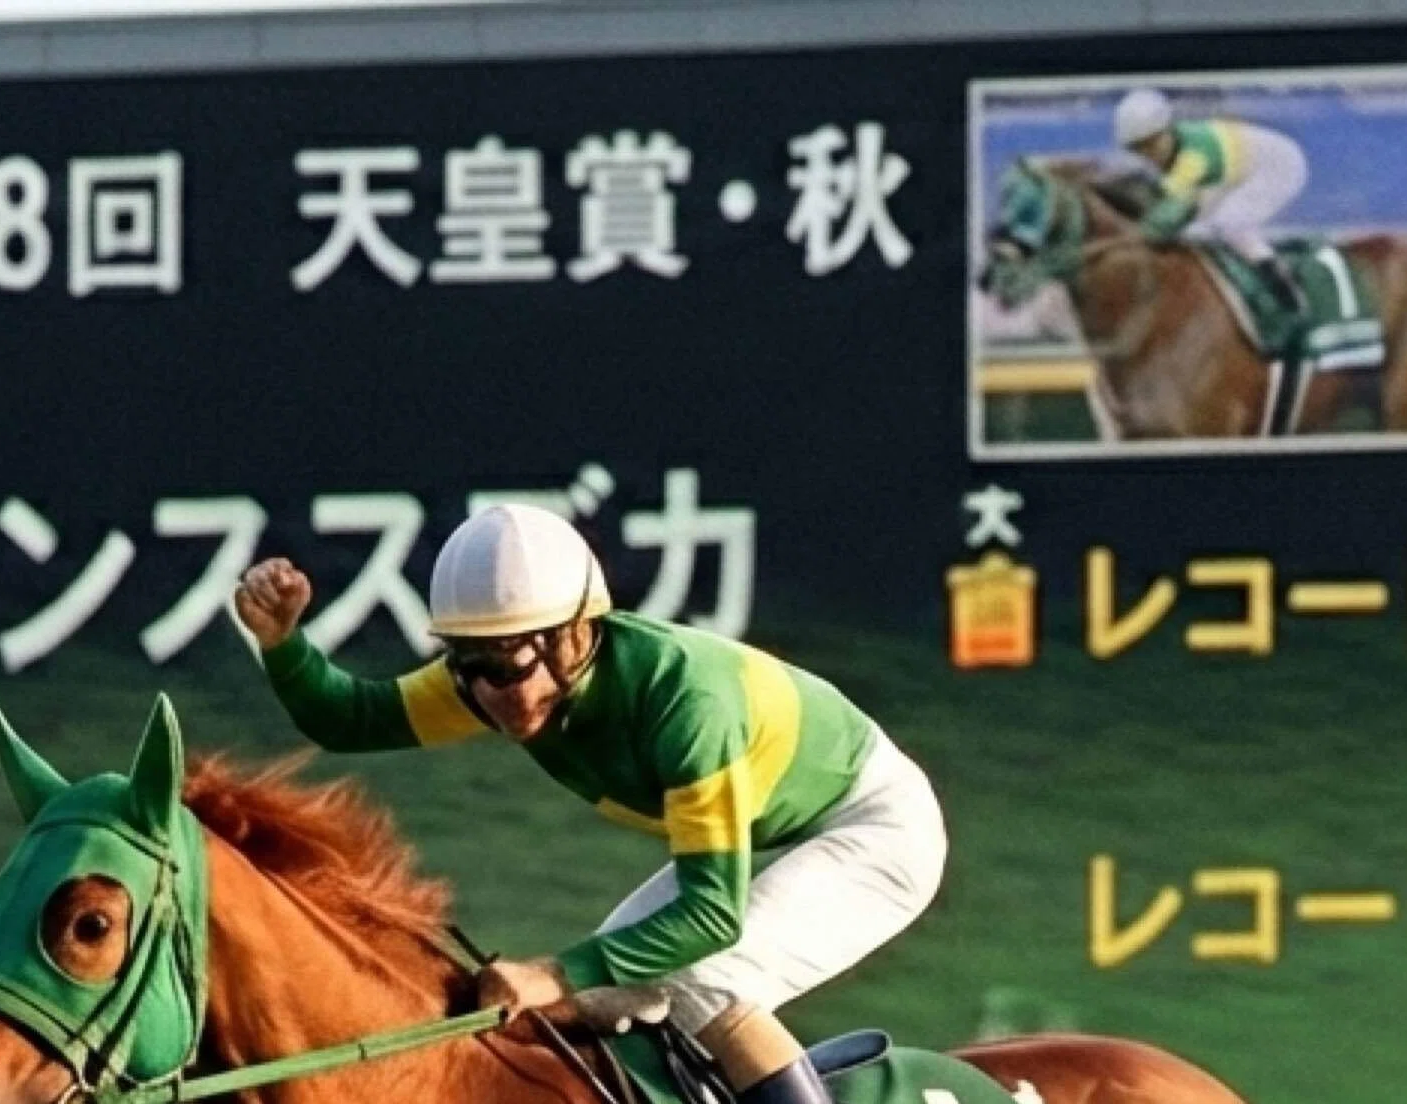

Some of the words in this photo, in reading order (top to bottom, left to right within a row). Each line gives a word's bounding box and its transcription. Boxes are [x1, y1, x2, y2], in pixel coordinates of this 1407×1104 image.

[290, 121, 914, 292] 天皇賞・秋
